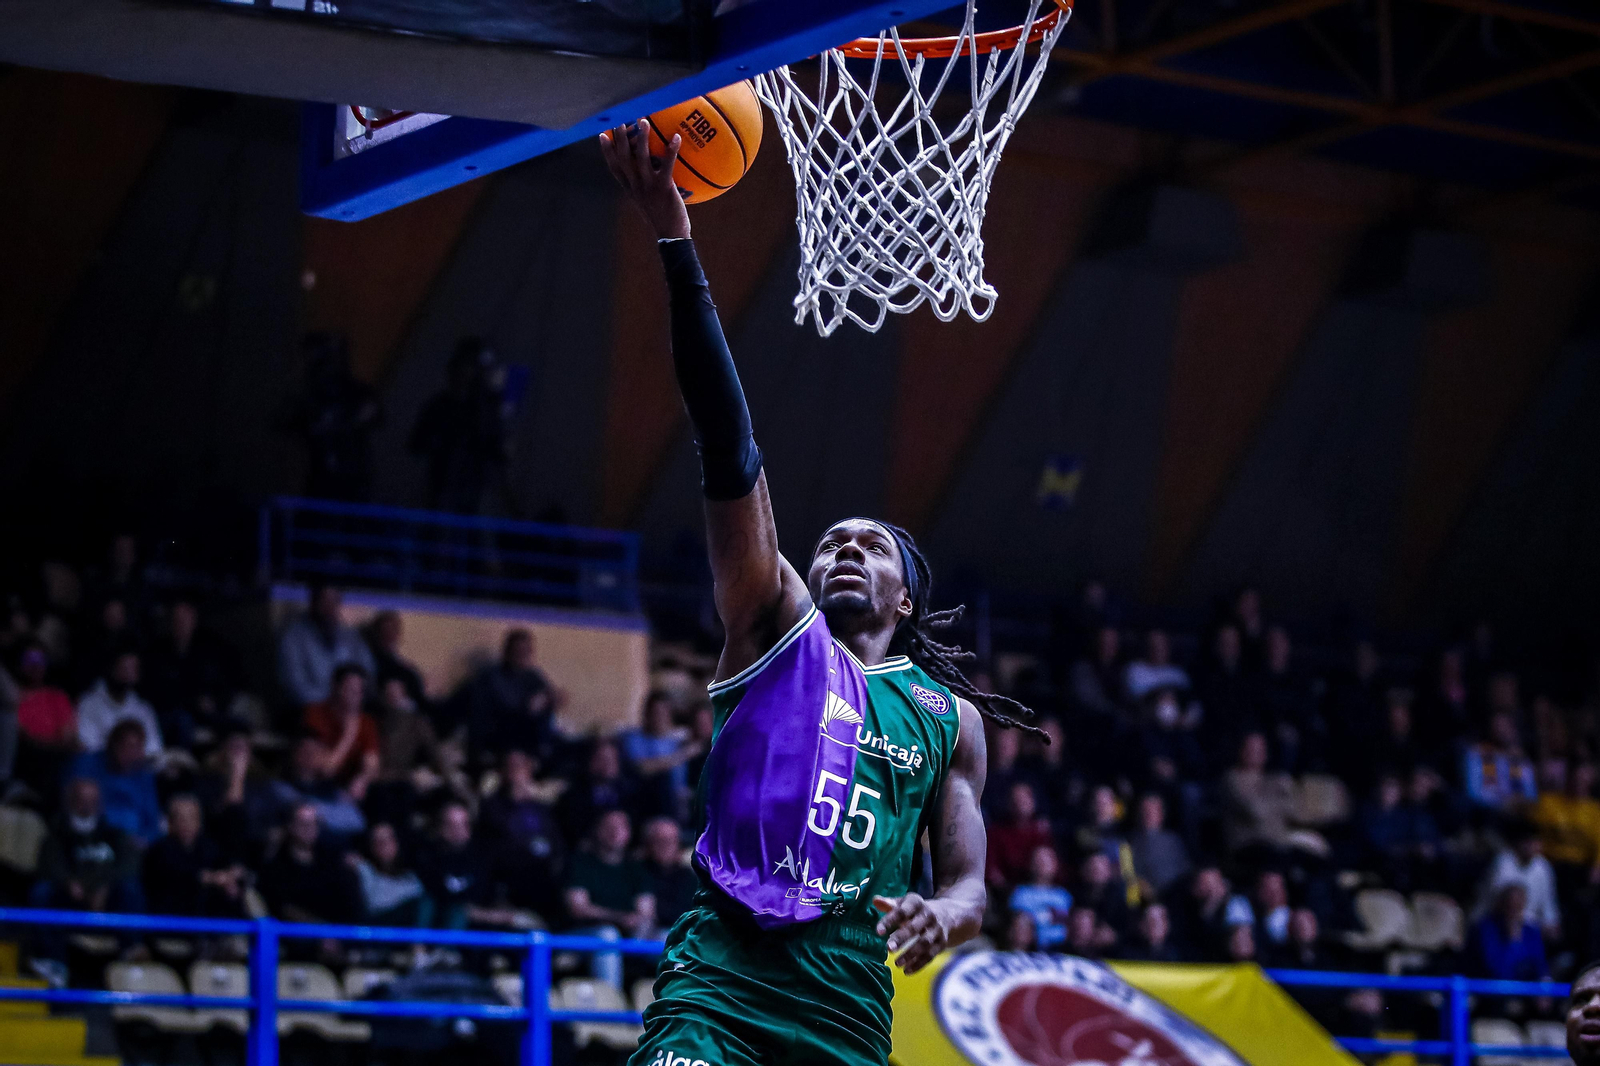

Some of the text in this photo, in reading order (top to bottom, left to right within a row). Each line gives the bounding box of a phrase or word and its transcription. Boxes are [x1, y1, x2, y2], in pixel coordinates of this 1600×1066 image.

[679, 121, 706, 149] APPROVED
[685, 109, 718, 144] FIBA
[855, 725, 923, 769] Unicaja
[807, 769, 881, 850] 55
